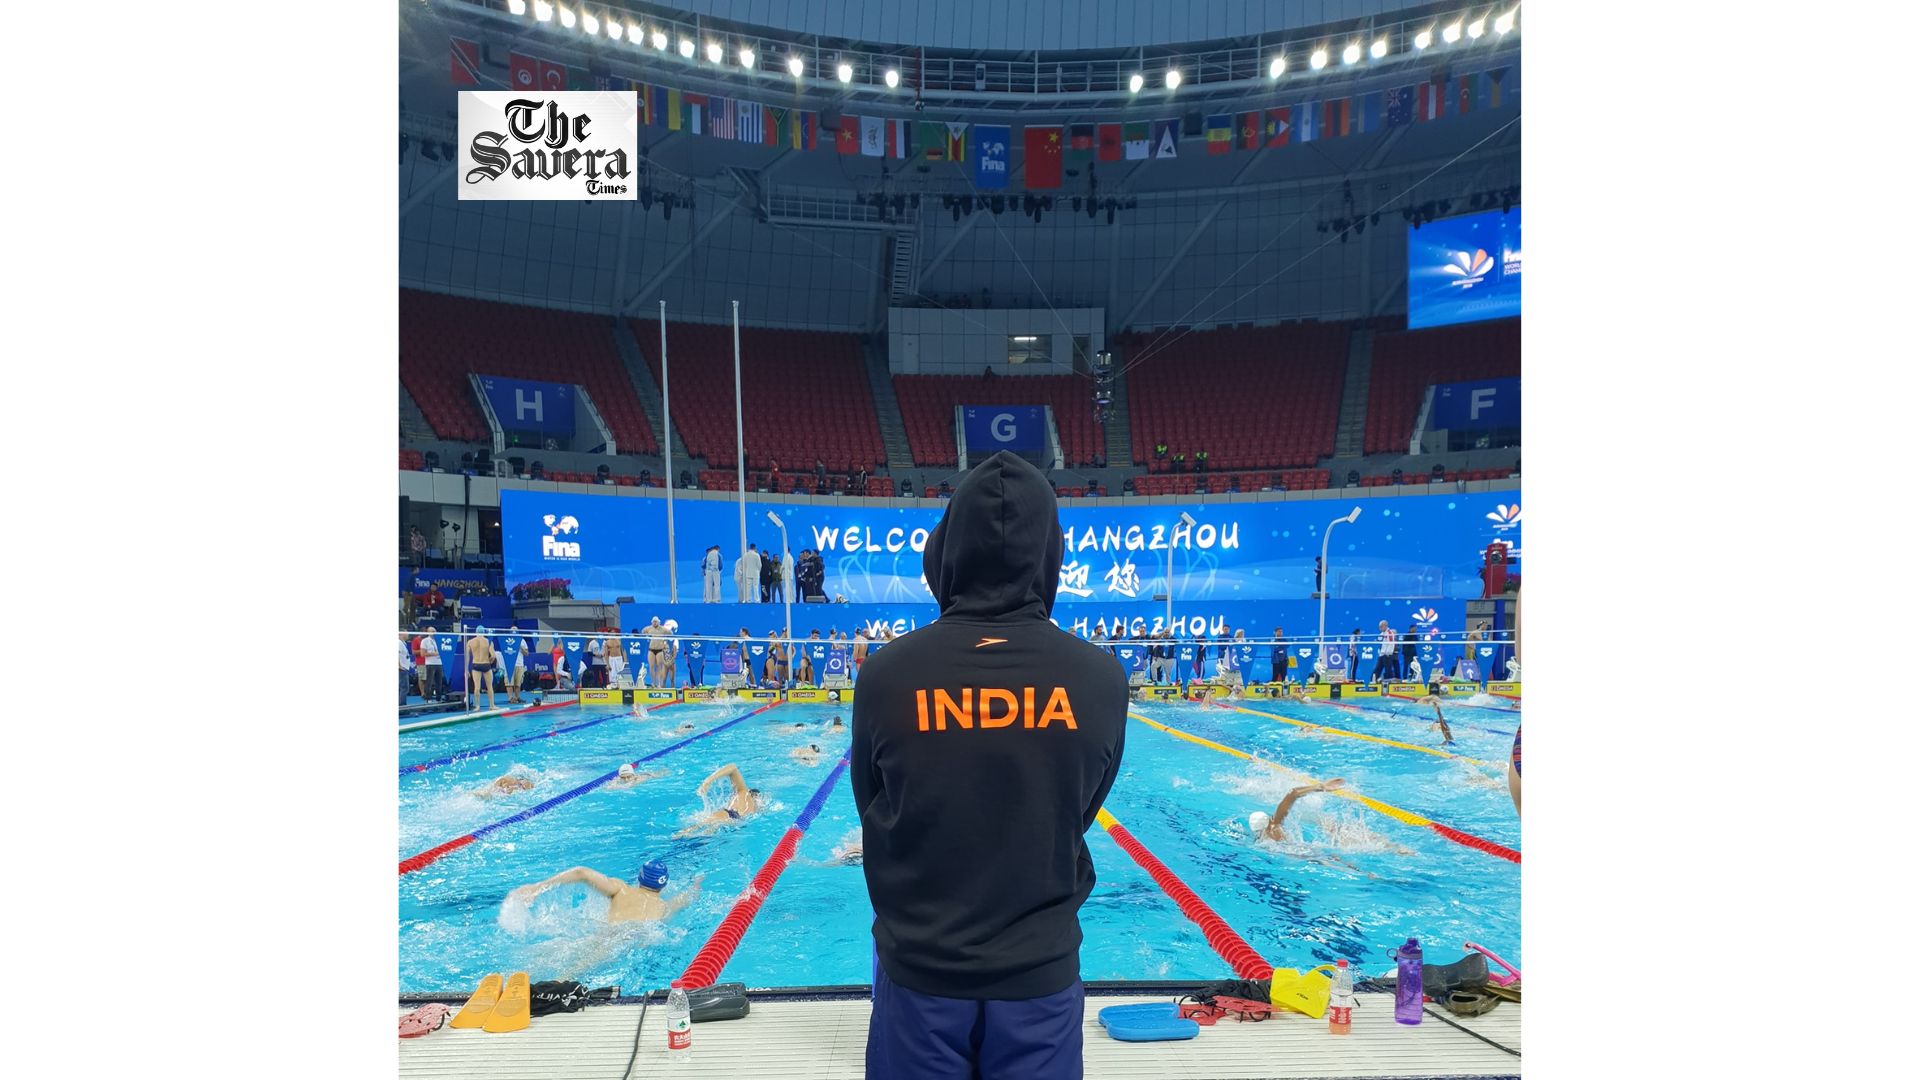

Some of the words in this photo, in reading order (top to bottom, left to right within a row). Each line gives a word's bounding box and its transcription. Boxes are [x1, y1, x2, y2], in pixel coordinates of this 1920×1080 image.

[515, 388, 544, 422] H
[1470, 388, 1497, 420] F
[990, 413, 1017, 442] G
[811, 525, 929, 553] WELCO
[916, 686, 1078, 731] INDIA
